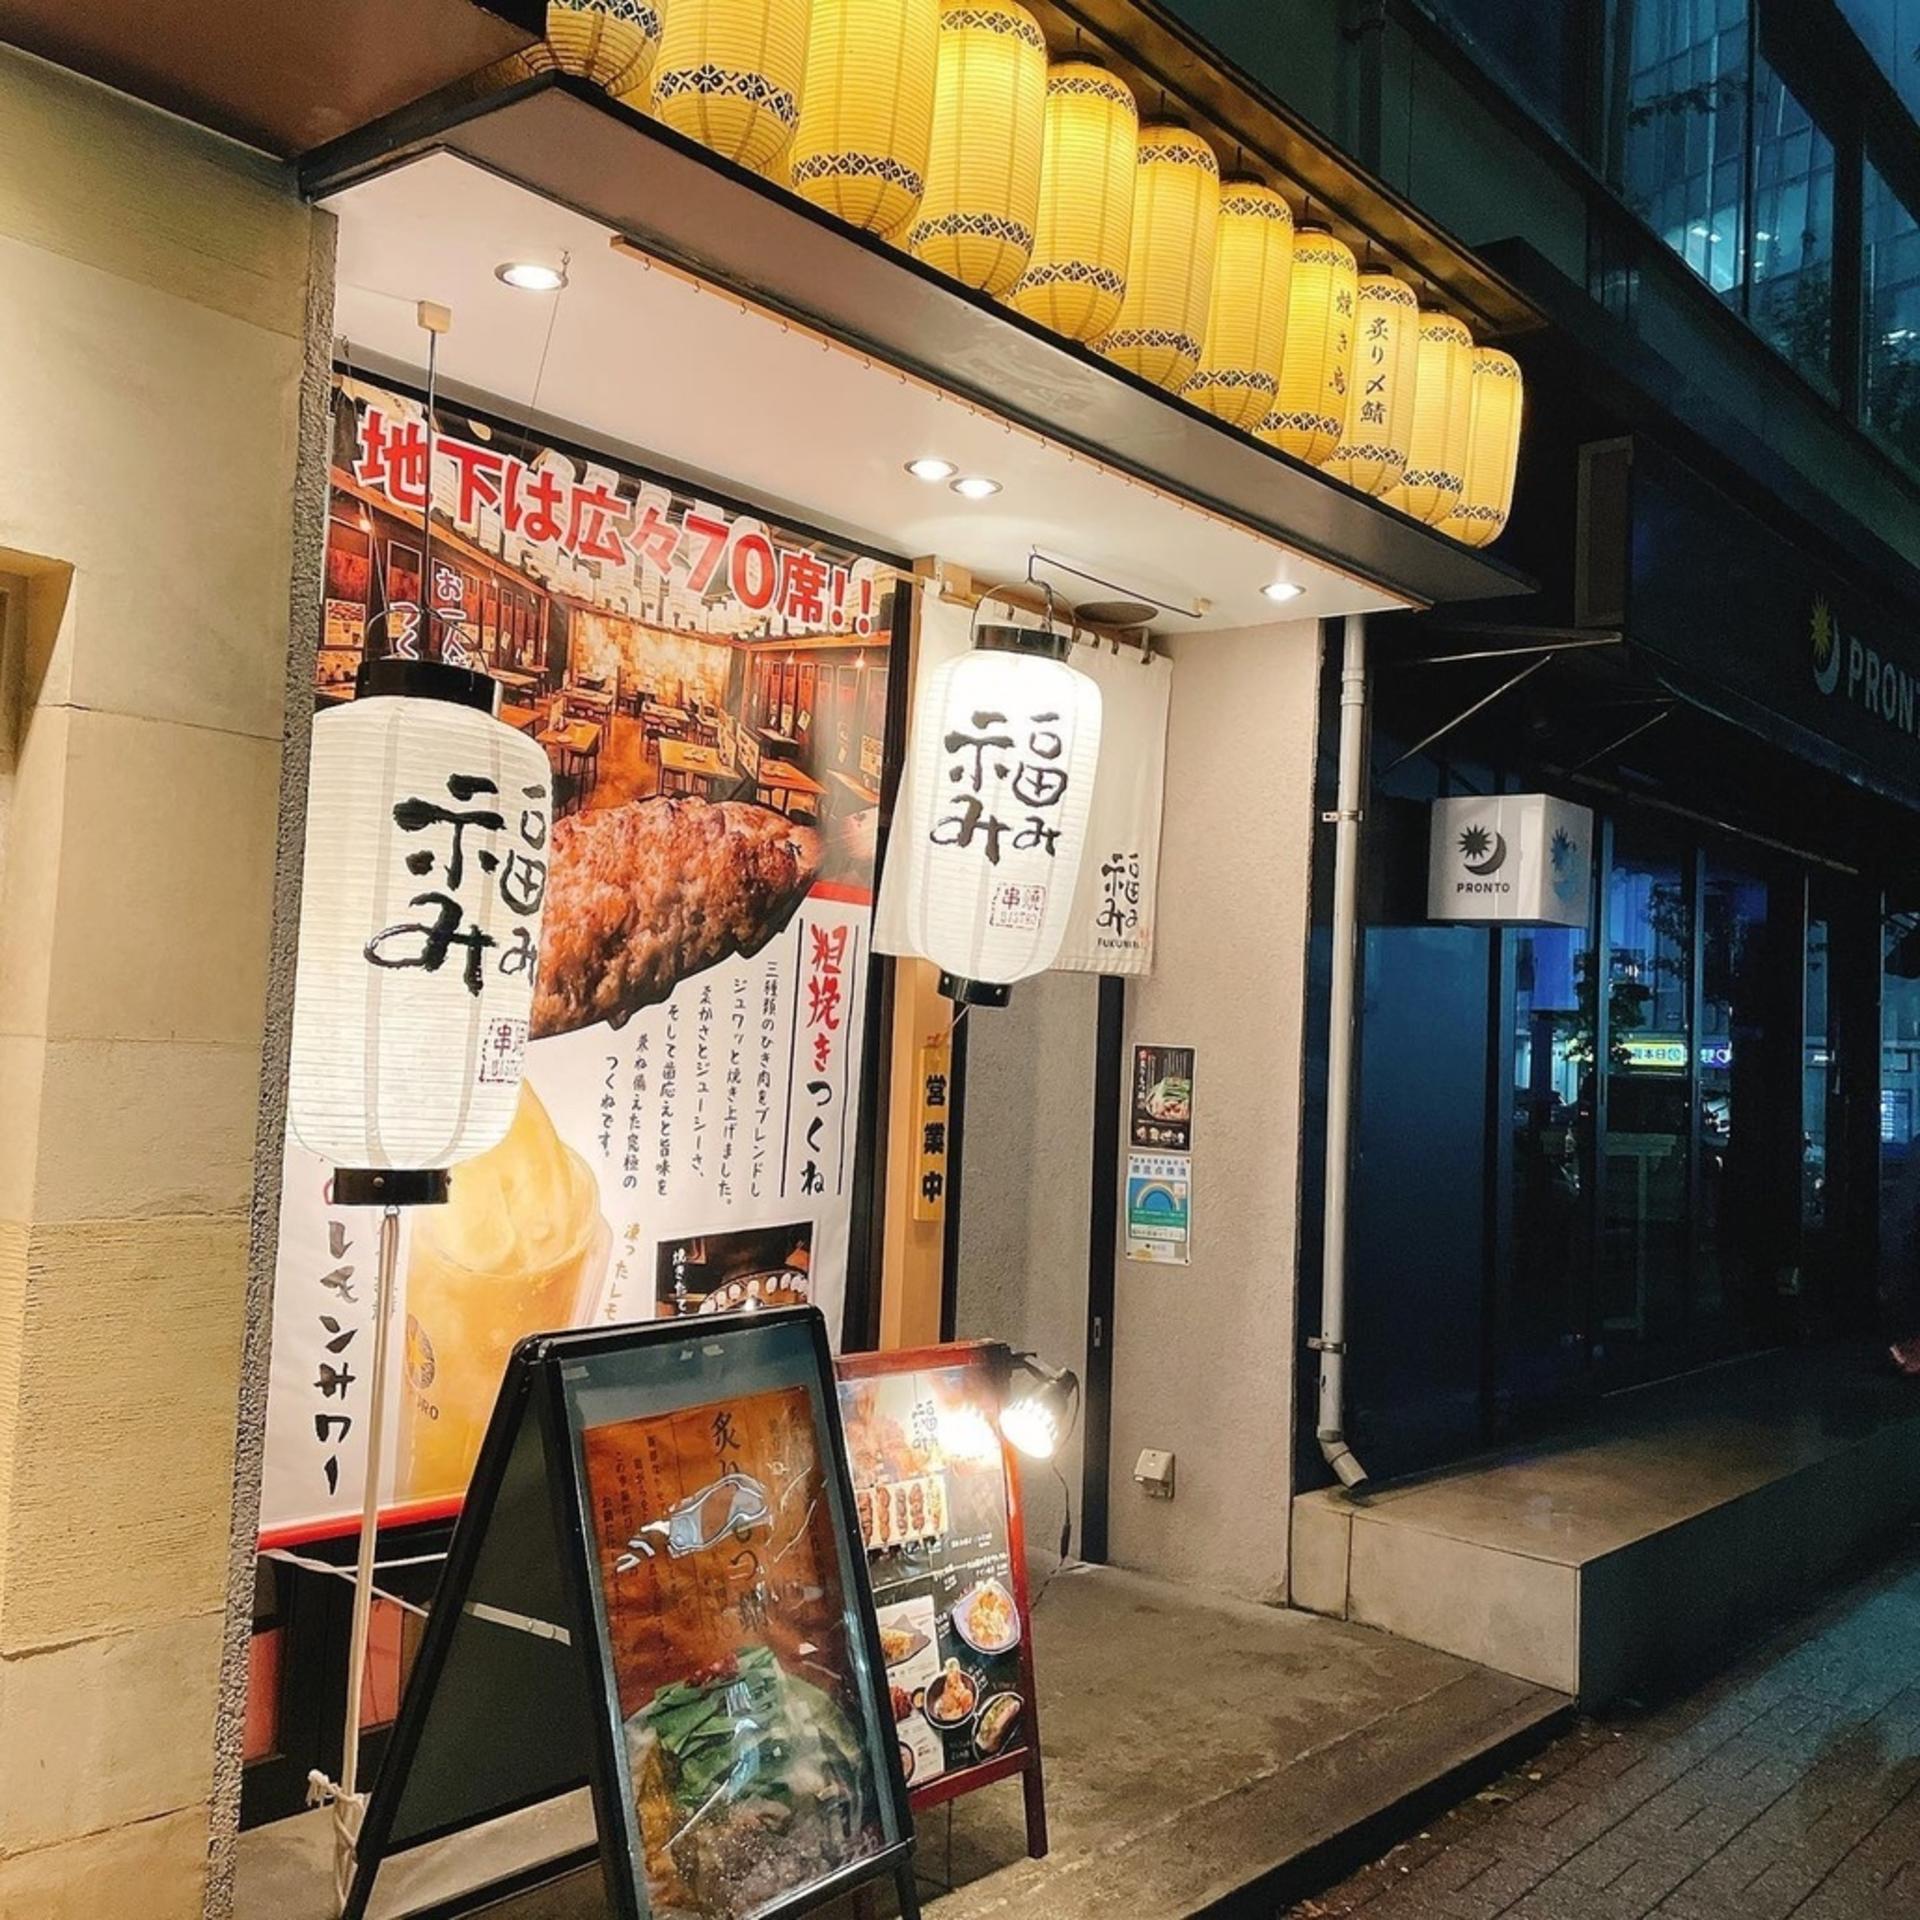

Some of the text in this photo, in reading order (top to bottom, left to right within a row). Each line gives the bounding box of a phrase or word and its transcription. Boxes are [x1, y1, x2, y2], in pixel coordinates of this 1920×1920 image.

[436, 567, 472, 667] お一人
[1848, 635, 1920, 739] PRON
[1457, 882, 1511, 893] PRONTO
[597, 1056, 619, 1158] つくねです。
[921, 1073, 948, 1204] 営業中
[313, 1220, 359, 1496] レモンサワー
